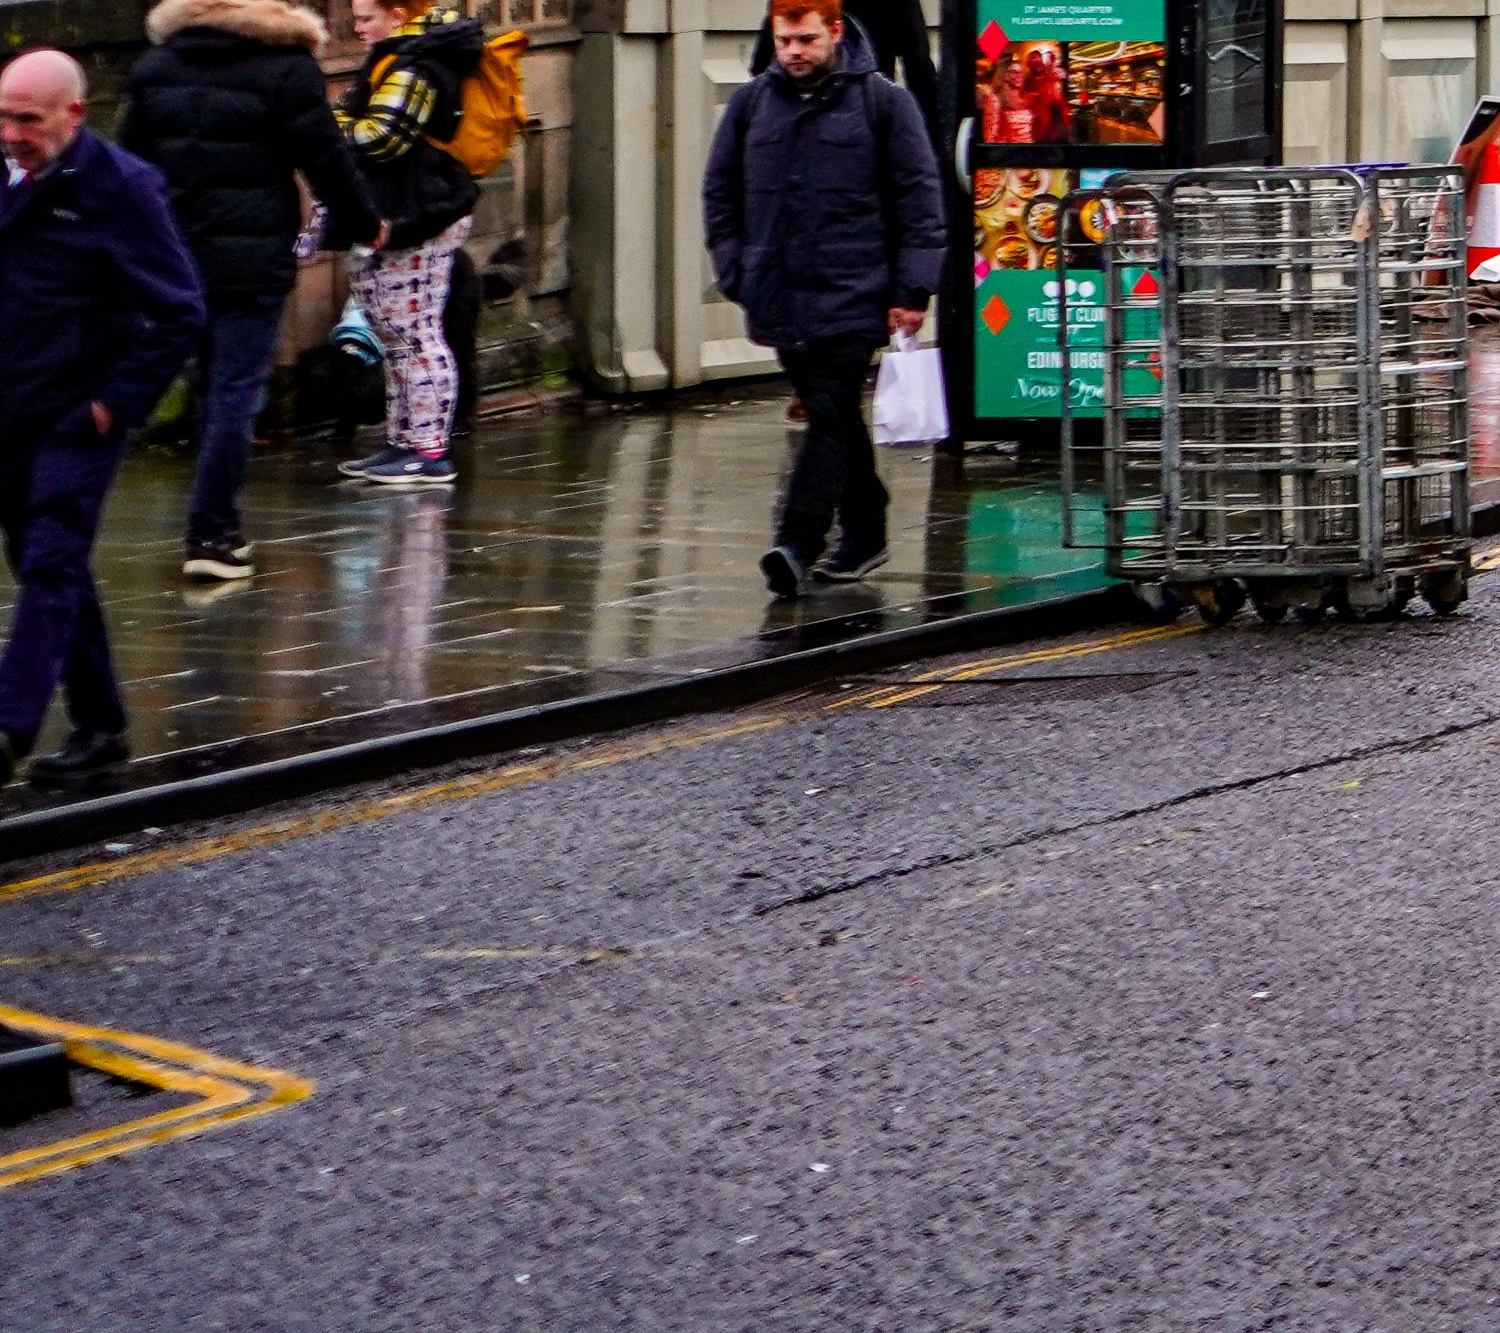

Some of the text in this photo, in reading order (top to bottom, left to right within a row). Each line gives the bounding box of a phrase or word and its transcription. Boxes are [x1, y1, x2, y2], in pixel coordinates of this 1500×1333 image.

[1027, 307, 1071, 323] FLIGT
[1027, 351, 1106, 369] EDINURG
[1010, 378, 1062, 399] Now
